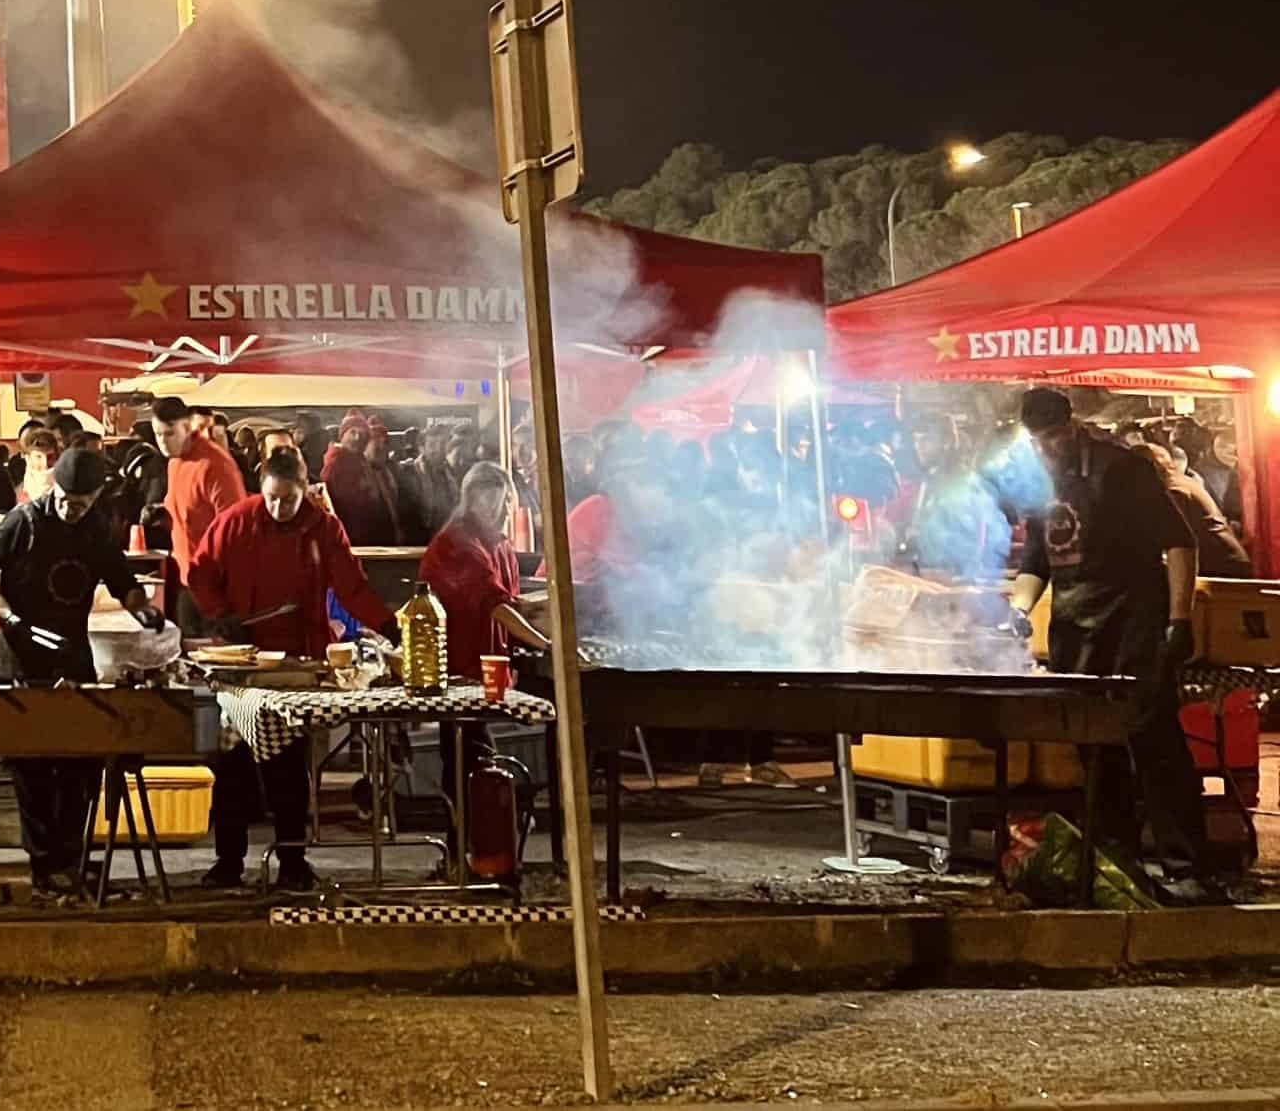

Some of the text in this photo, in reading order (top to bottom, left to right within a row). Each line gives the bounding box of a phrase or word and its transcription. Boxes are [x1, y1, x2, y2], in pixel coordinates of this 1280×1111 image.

[188, 284, 396, 320] ESTRELLA
[967, 323, 1200, 359] ESTRELLA DAMM
